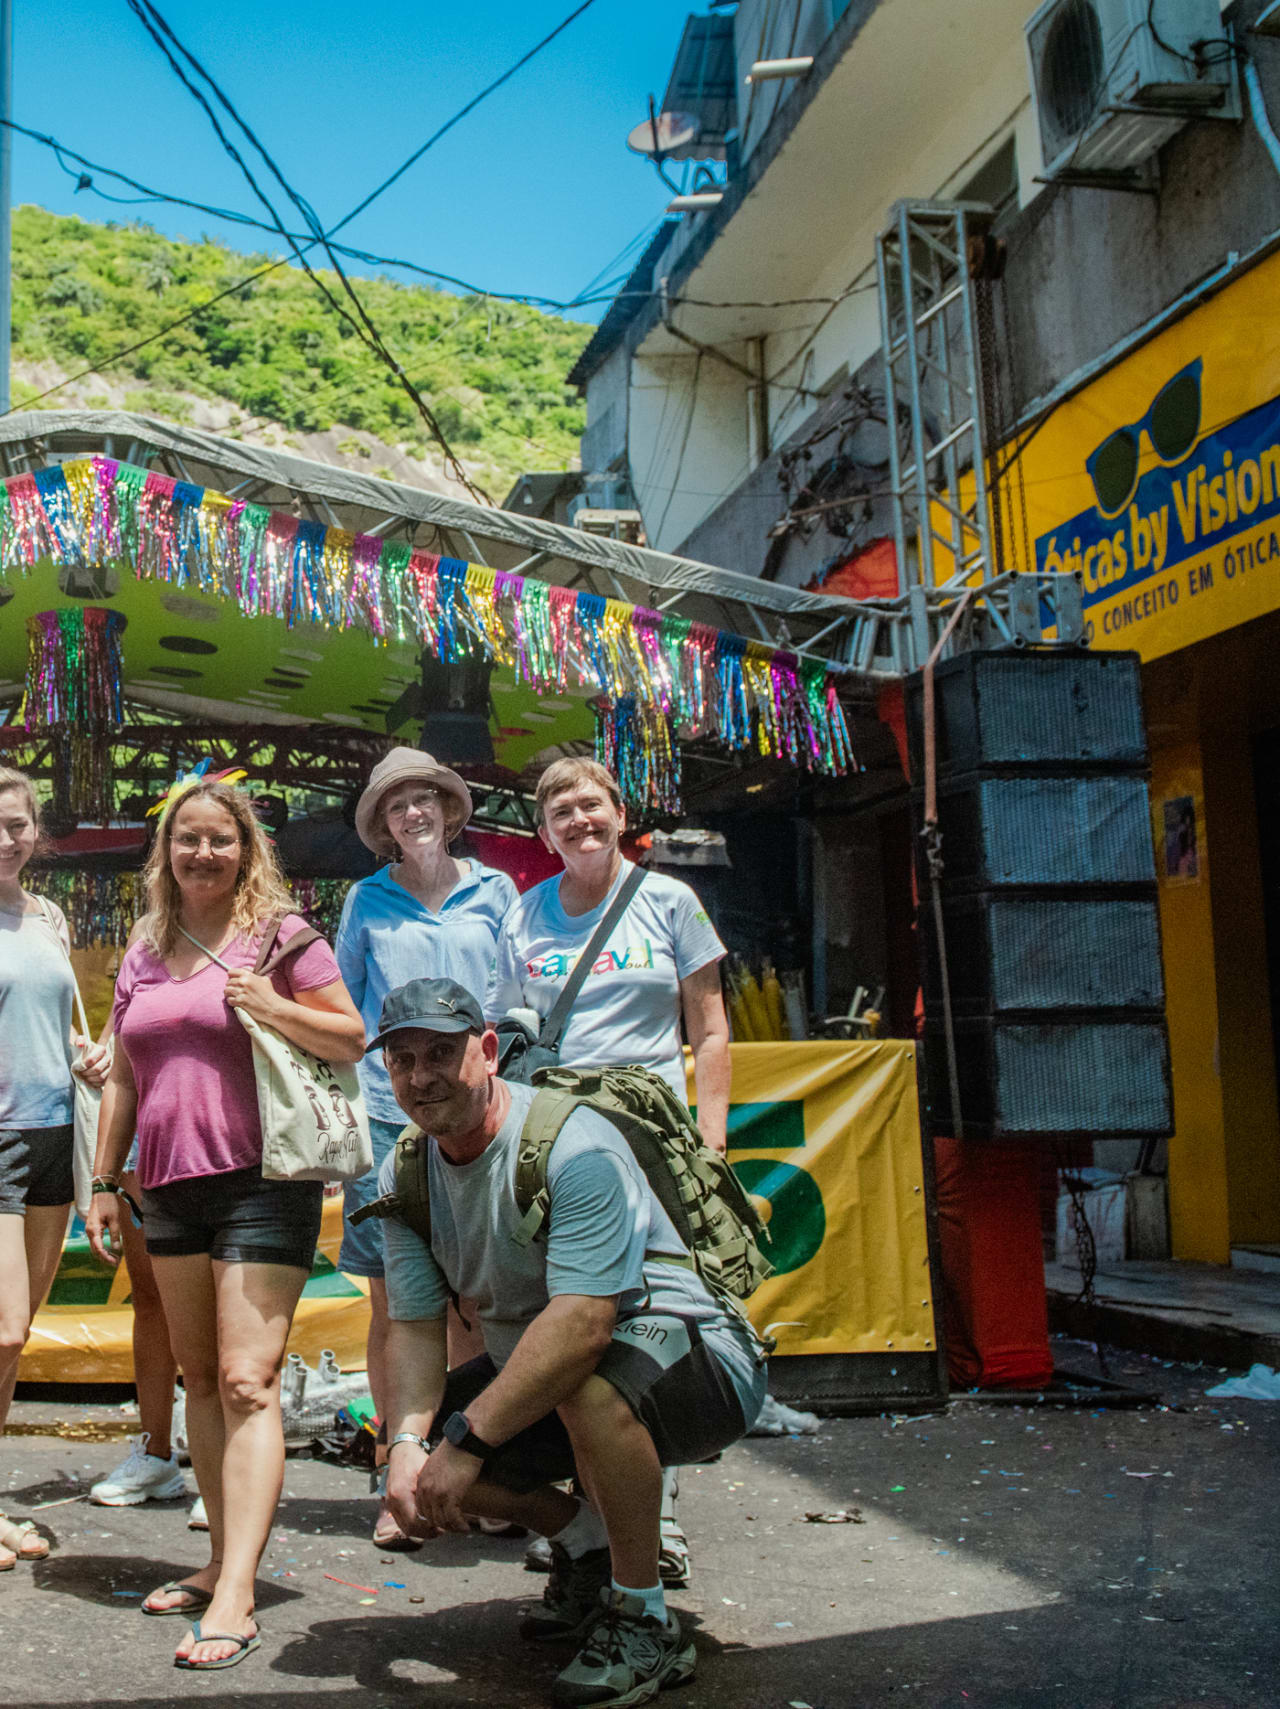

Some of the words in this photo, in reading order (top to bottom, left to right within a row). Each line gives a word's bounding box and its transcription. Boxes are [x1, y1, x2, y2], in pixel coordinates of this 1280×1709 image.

[1129, 503, 1169, 571] by
[1171, 443, 1280, 545] Vision
[1103, 579, 1179, 635] CONCEITO
[1188, 562, 1214, 597] EM
[526, 938, 654, 978] caraval
